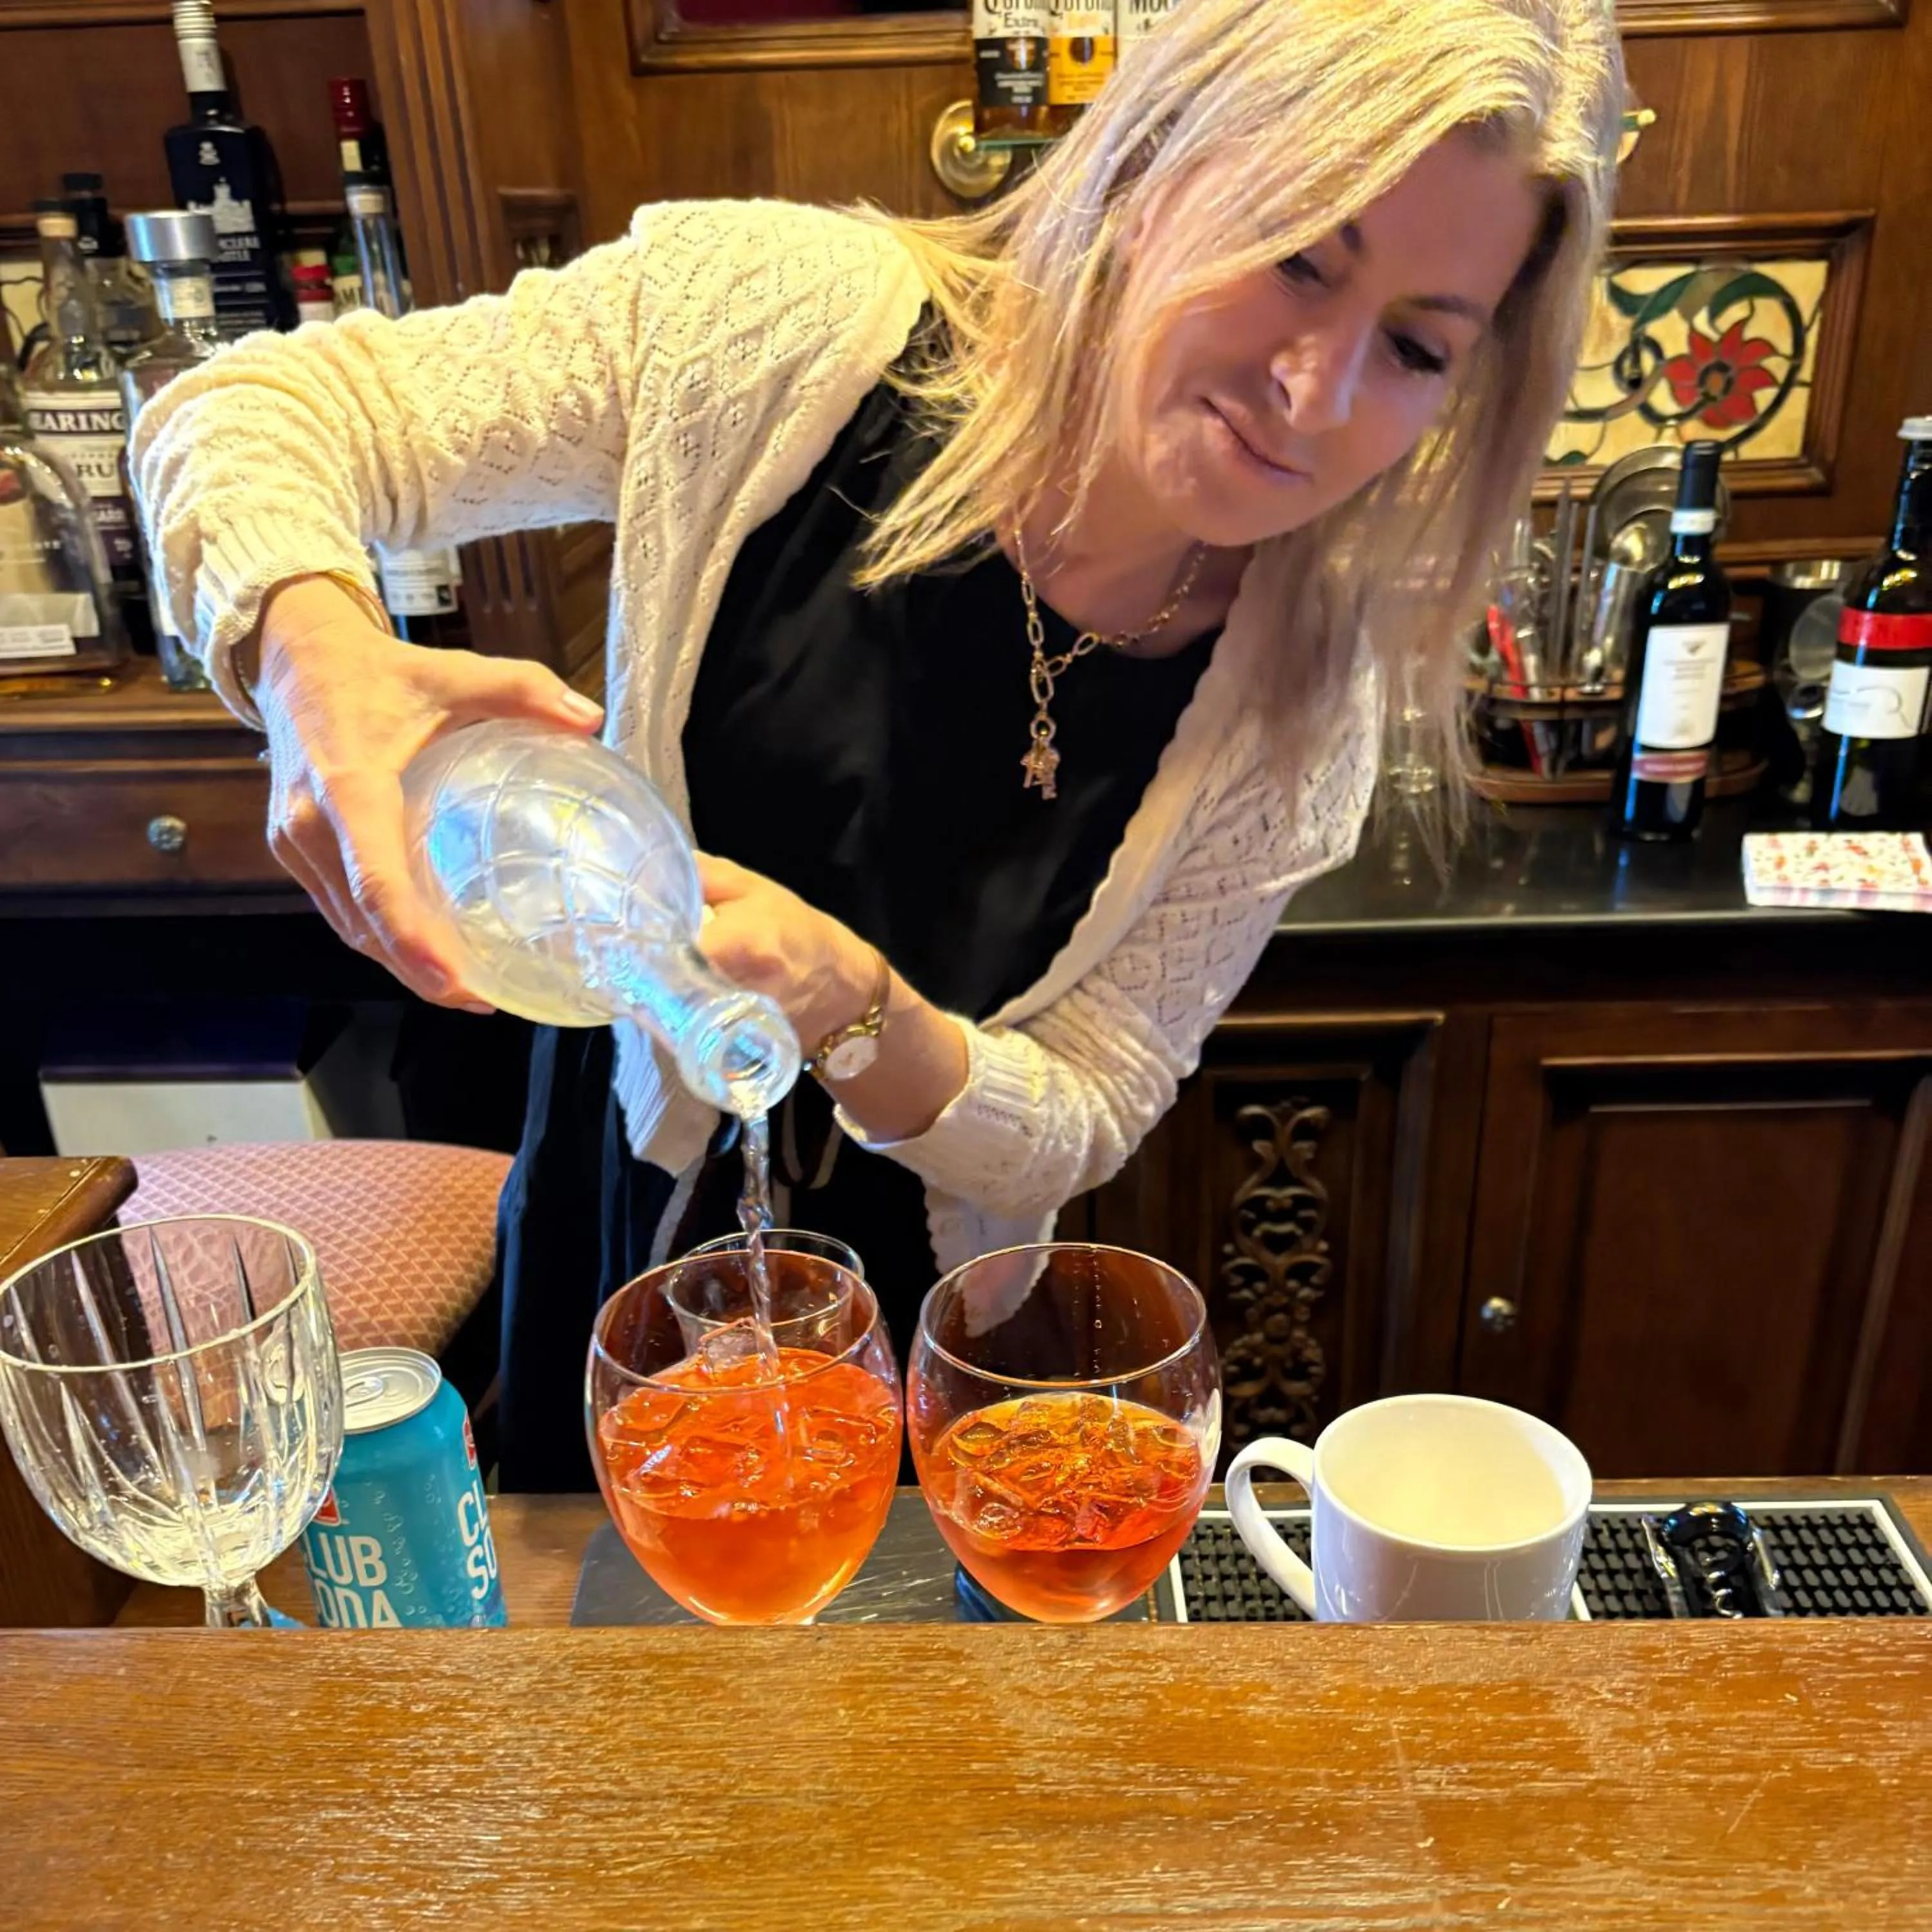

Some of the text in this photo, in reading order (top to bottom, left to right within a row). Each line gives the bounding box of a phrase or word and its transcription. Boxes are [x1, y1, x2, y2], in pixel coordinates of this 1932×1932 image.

[1004, 12, 1039, 28] Extra
[76, 463, 115, 478] RU
[457, 1480, 488, 1547] CL
[303, 1531, 387, 1587] LUB
[466, 1525, 498, 1600] SO
[314, 1578, 403, 1628] ODA
